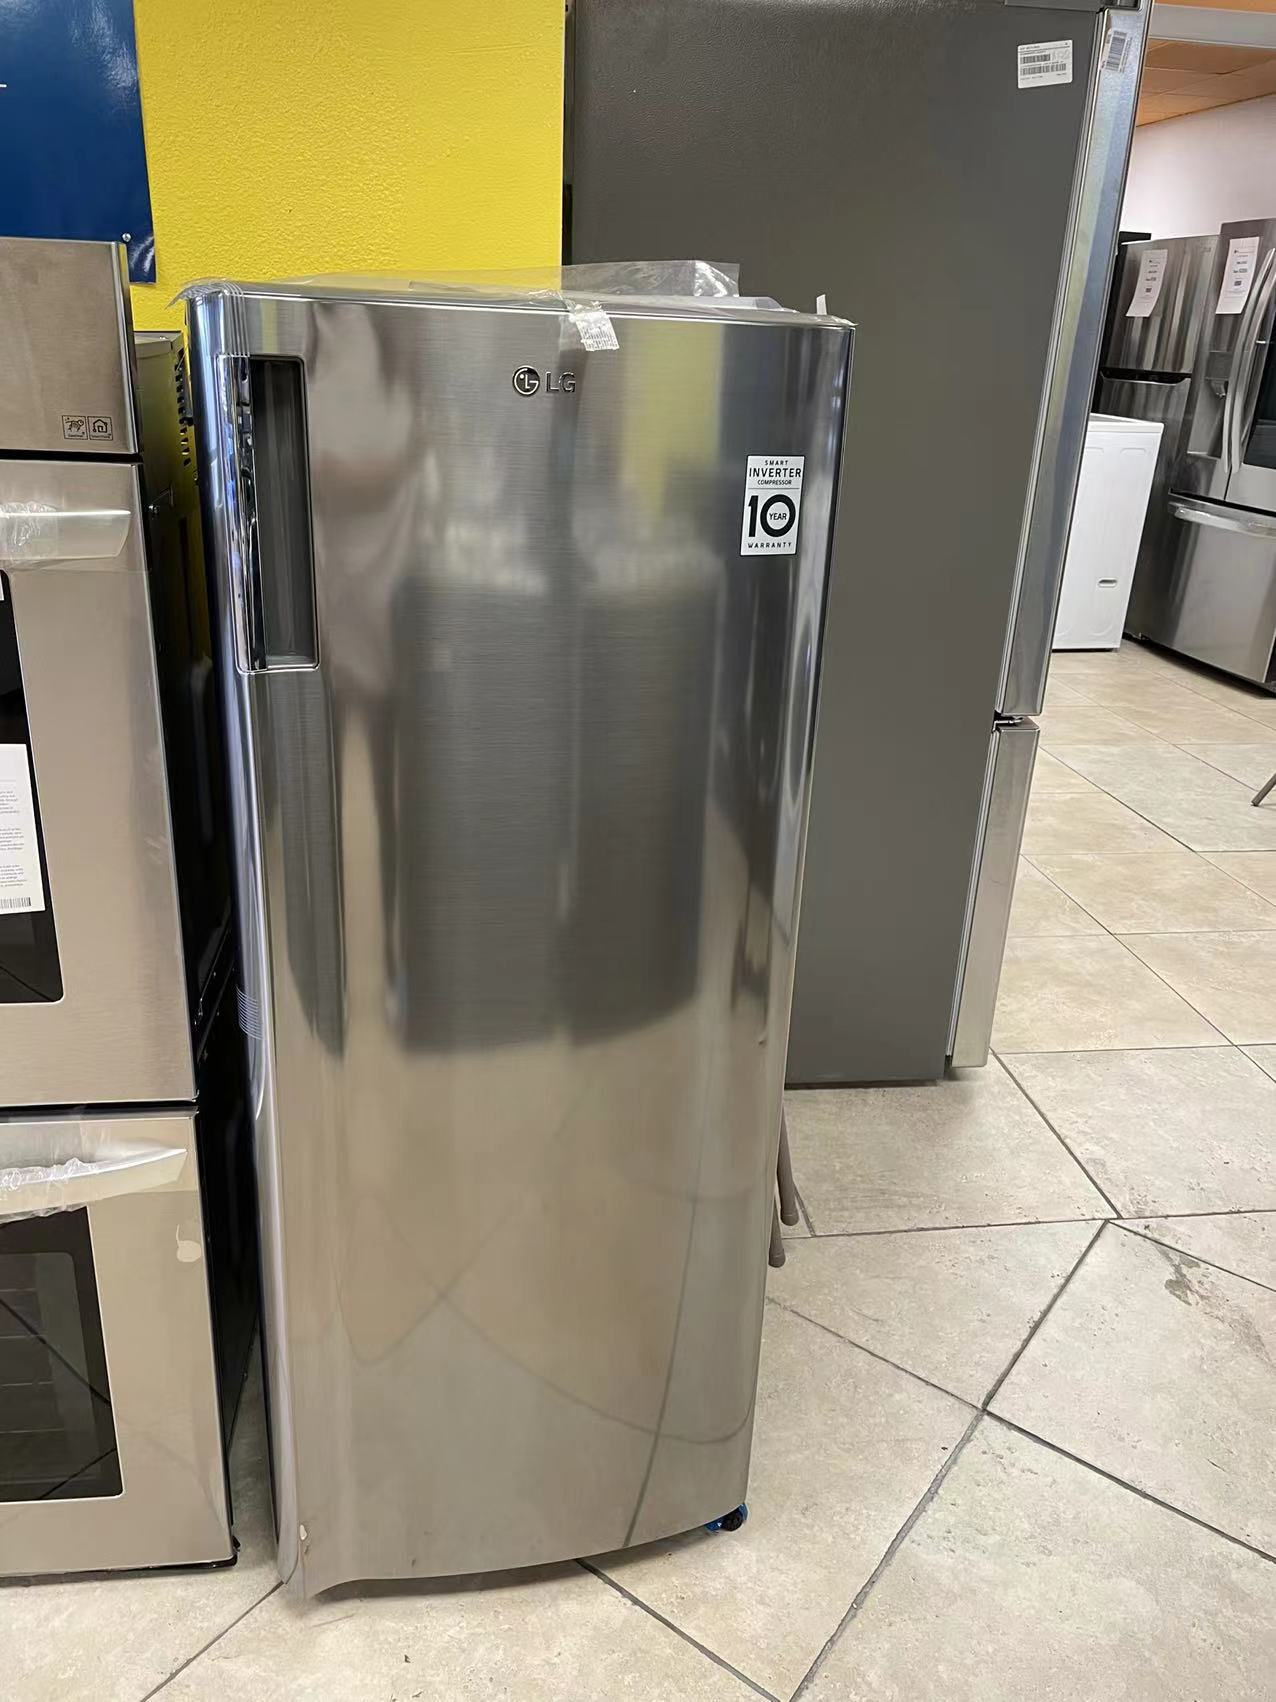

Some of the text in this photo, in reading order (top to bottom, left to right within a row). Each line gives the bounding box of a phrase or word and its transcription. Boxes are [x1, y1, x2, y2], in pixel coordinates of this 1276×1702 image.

[545, 372, 576, 393] LG
[749, 467, 802, 478] INVERTER
[748, 494, 796, 537] 10 YEAR
